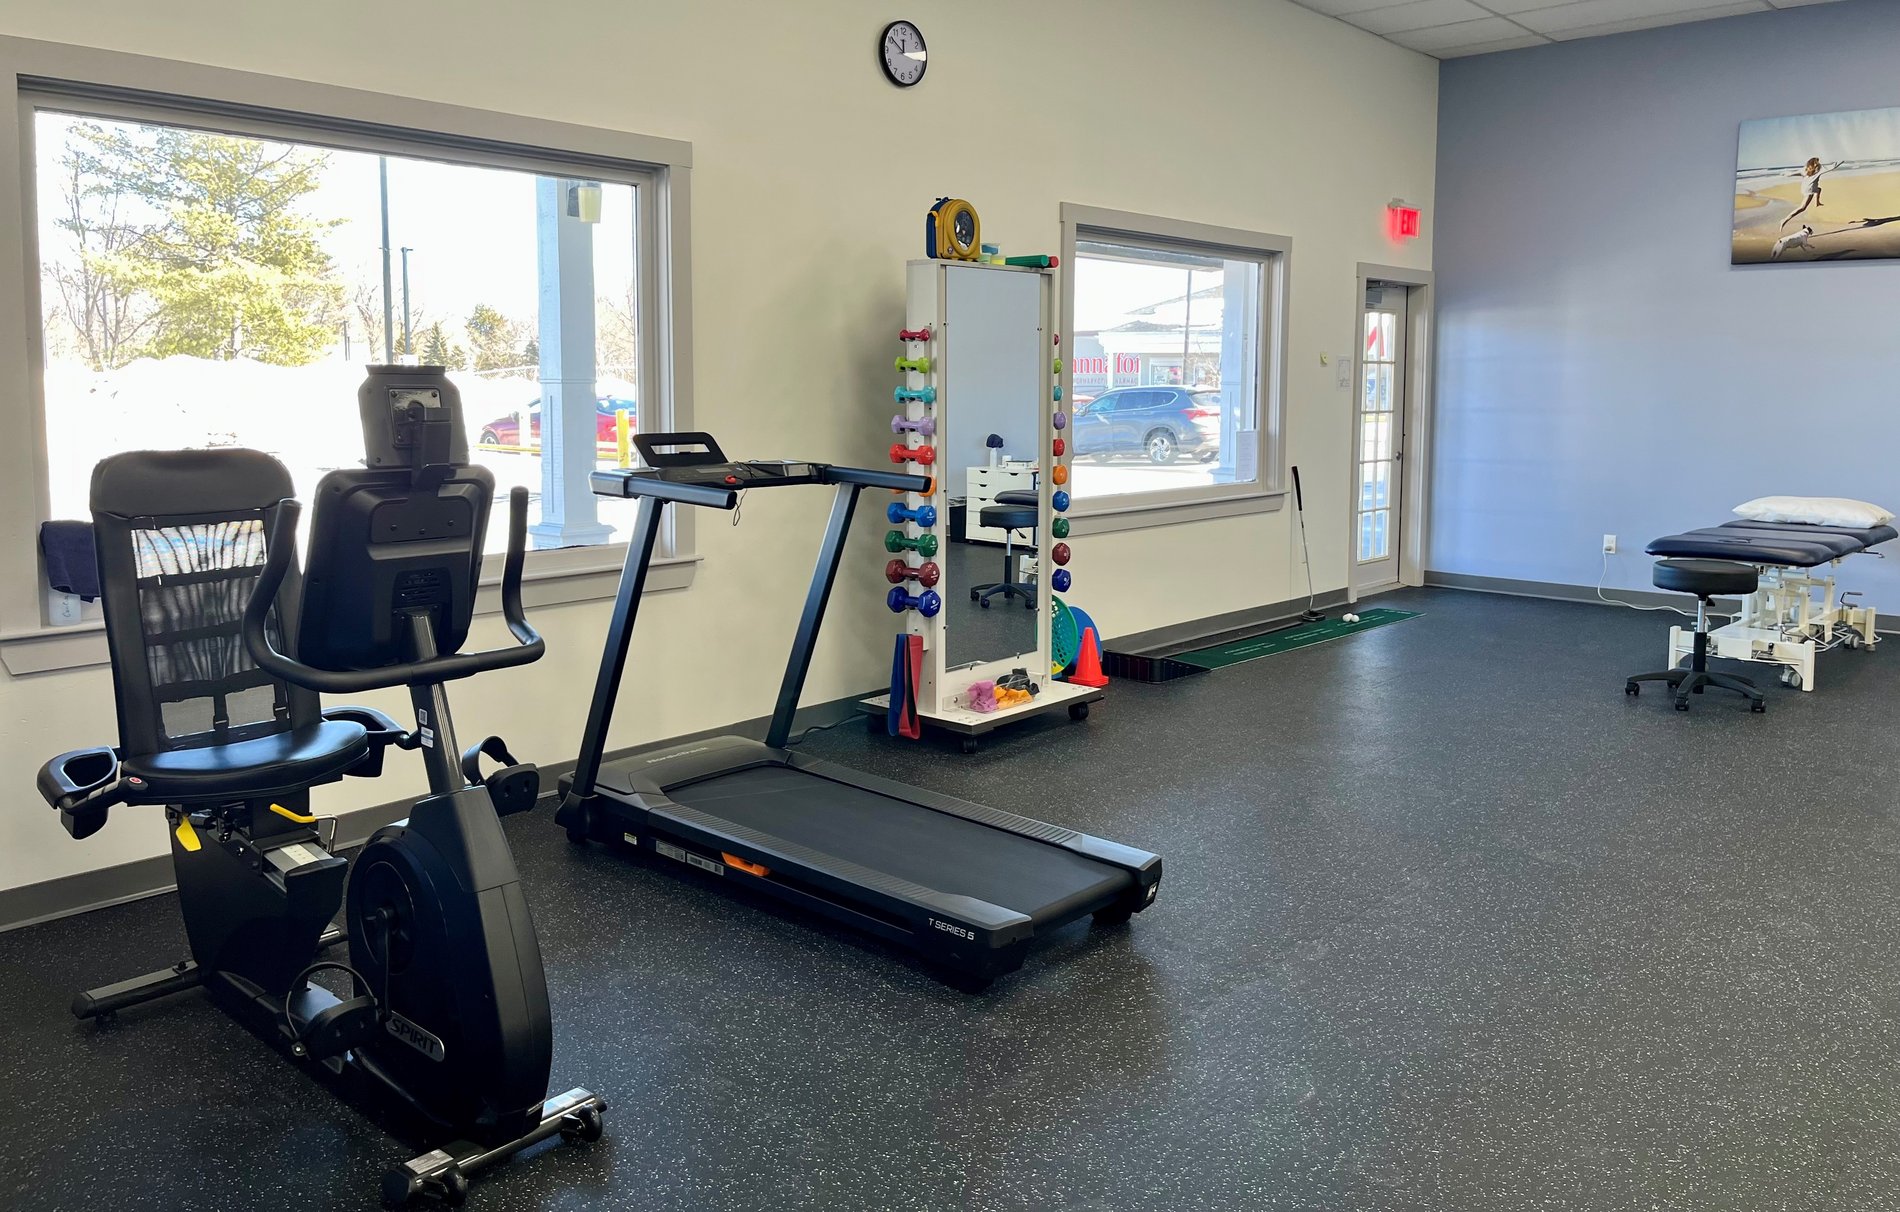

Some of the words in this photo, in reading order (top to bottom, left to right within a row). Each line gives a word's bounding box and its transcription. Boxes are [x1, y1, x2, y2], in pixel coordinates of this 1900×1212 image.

[893, 28, 899, 37] 11
[900, 27, 907, 36] 12
[914, 41, 919, 50] 2
[887, 58, 892, 67] 8
[893, 67, 898, 76] 7
[908, 71, 913, 80] 5
[900, 72, 905, 81] 6
[928, 917, 935, 926] T
[934, 920, 967, 938] SERIES
[967, 931, 976, 941] 5
[390, 1018, 438, 1054] SPIRIT
